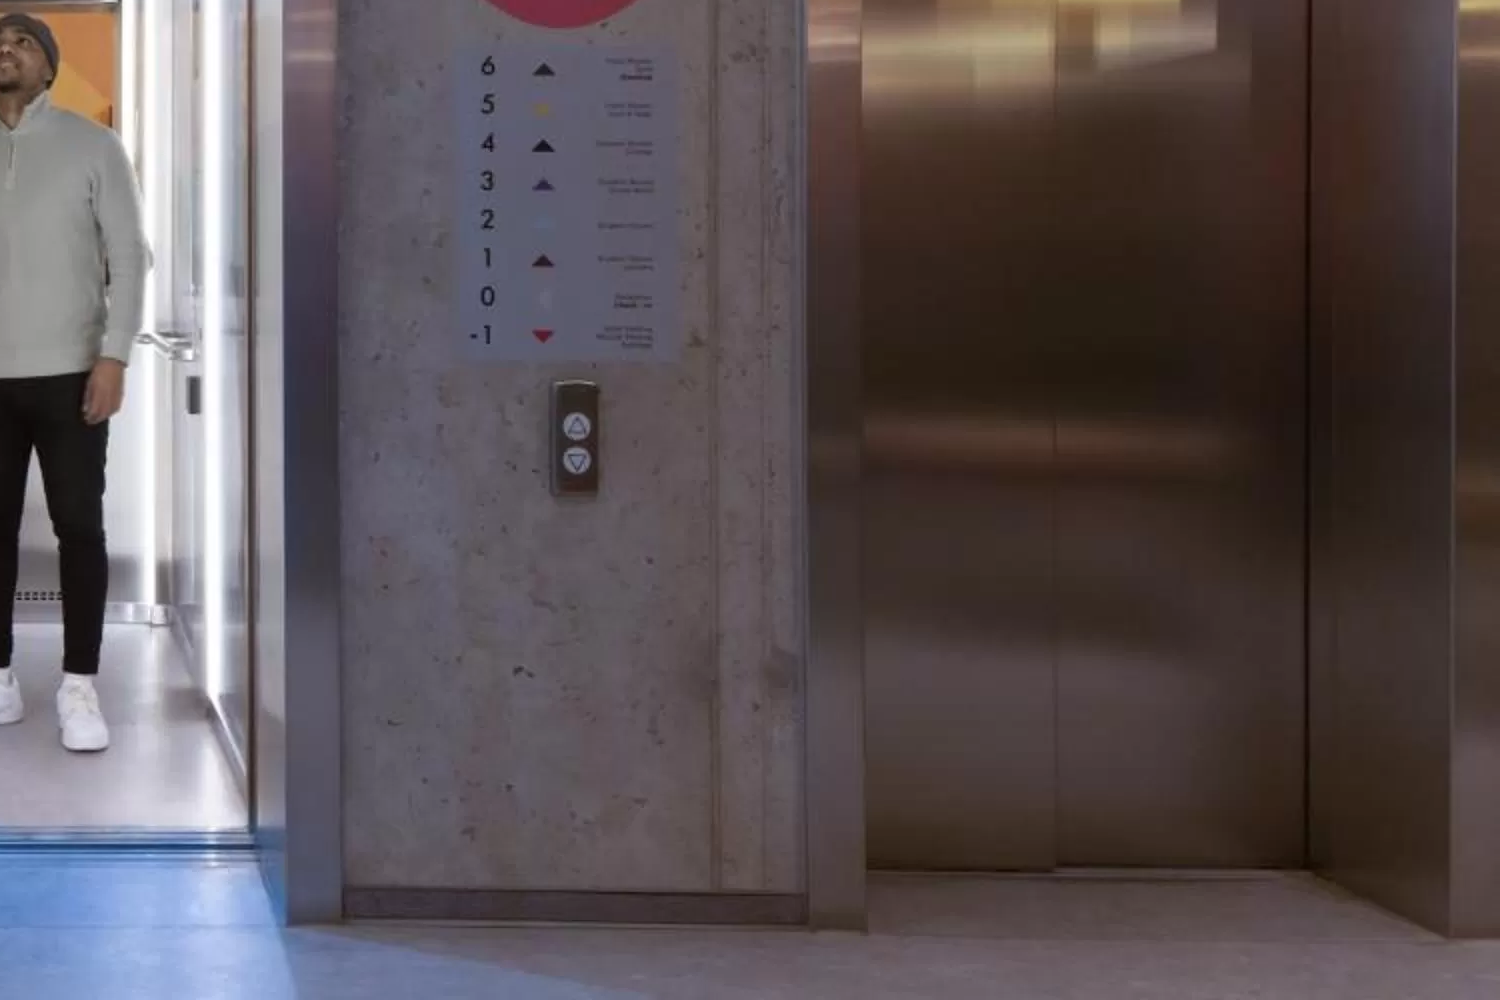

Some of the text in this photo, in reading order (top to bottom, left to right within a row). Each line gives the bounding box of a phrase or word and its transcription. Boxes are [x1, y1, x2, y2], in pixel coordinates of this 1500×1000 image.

[480, 55, 496, 76] 6
[480, 93, 496, 114] 5
[480, 132, 495, 152] 4
[479, 170, 495, 191] 3
[480, 208, 495, 230] 2
[483, 247, 492, 268] 1
[480, 285, 496, 307] 0
